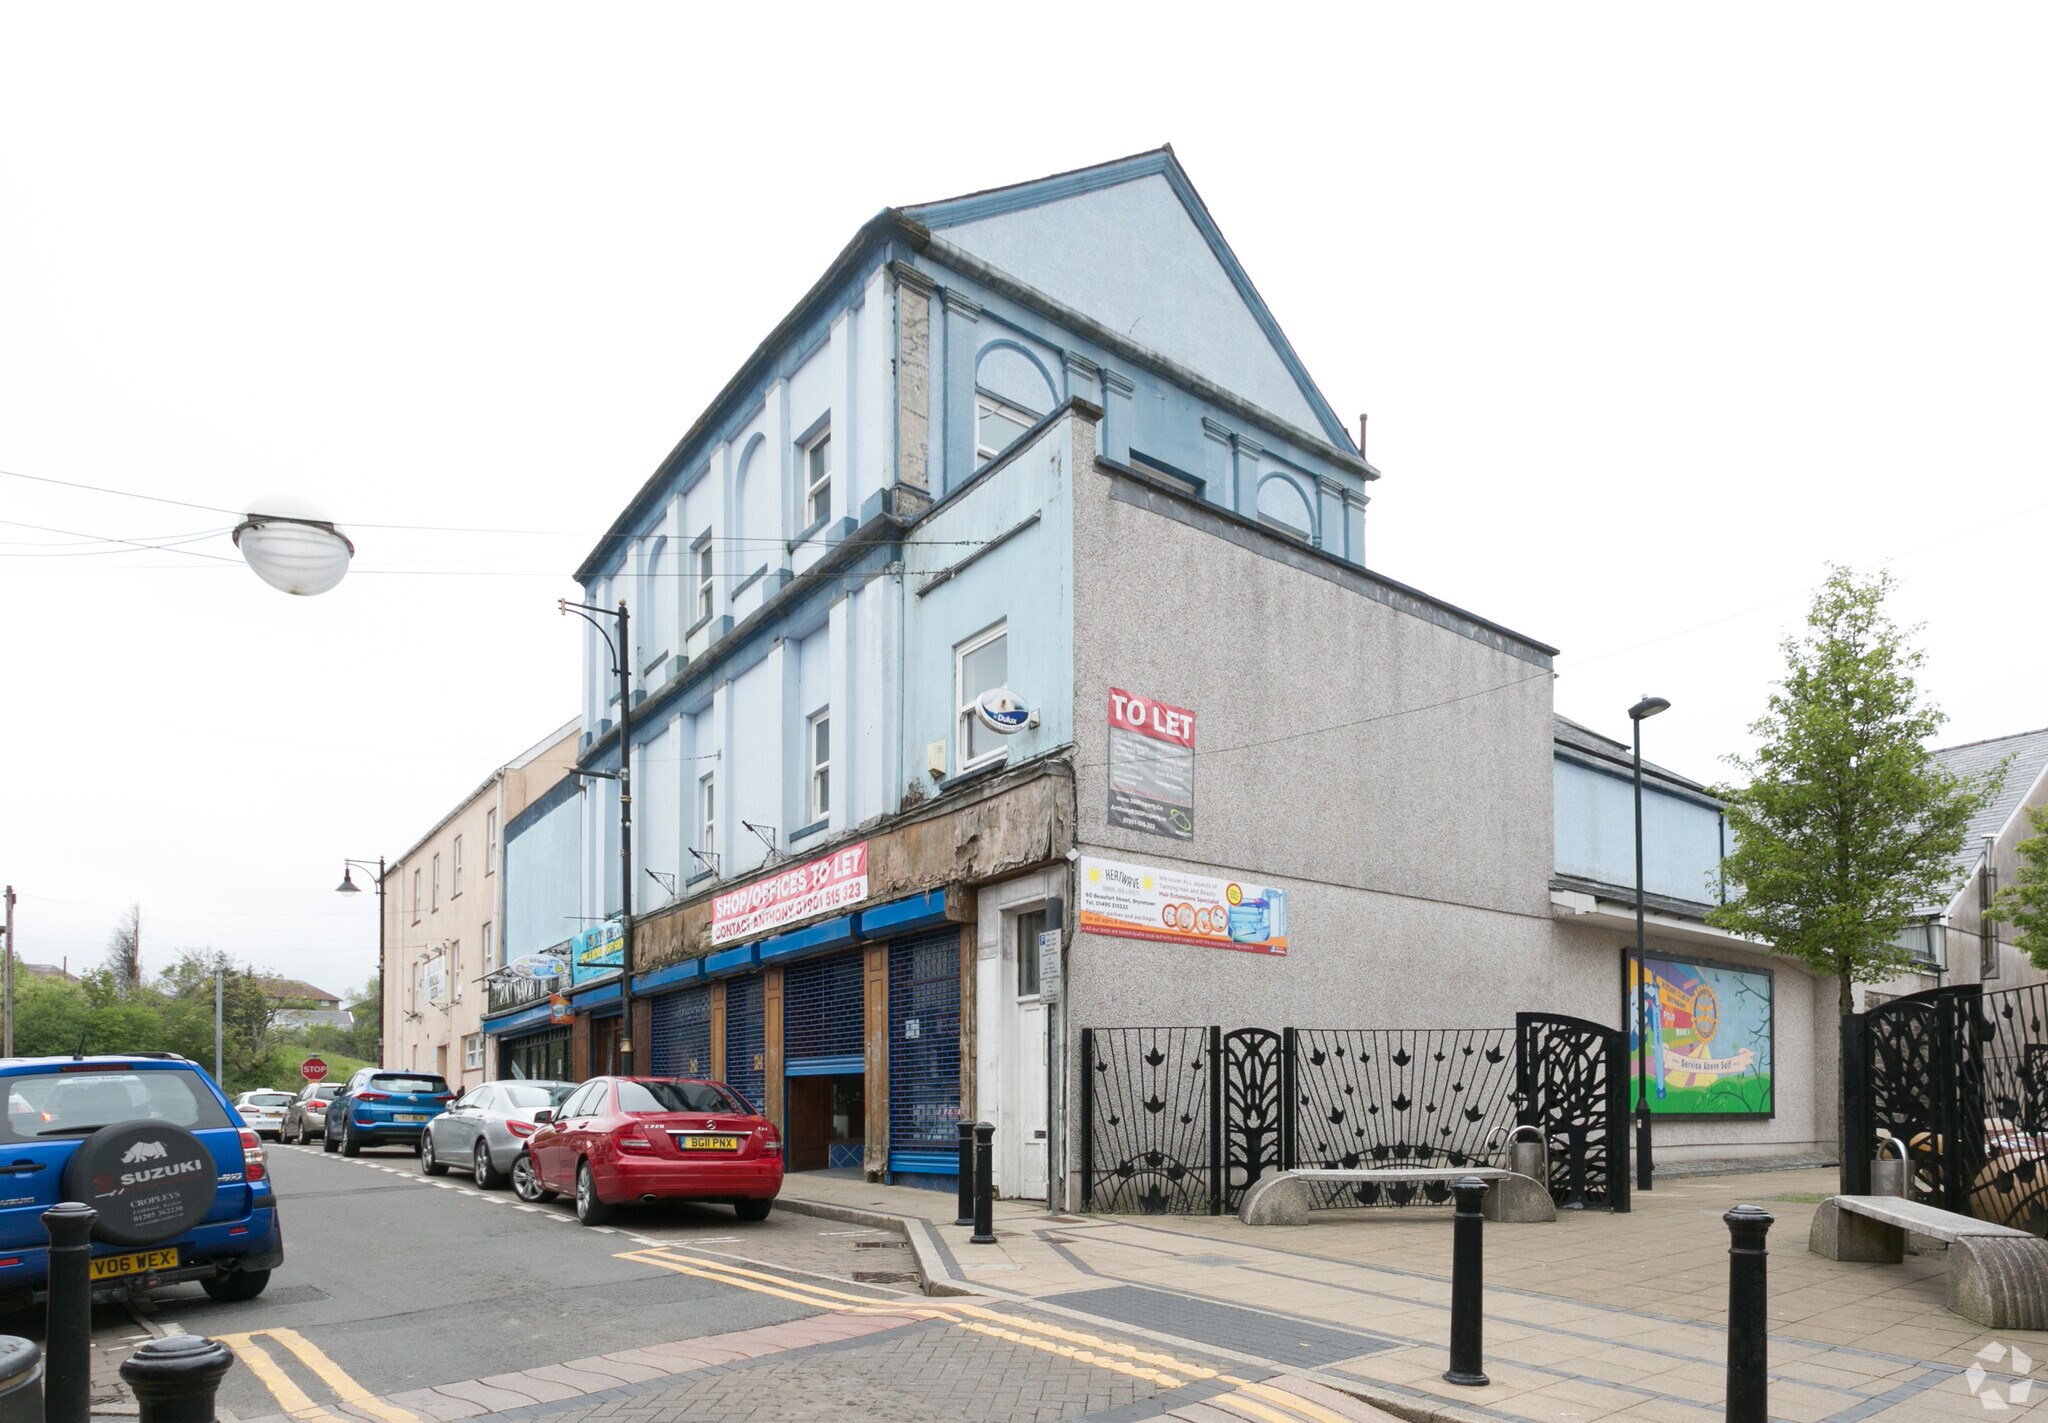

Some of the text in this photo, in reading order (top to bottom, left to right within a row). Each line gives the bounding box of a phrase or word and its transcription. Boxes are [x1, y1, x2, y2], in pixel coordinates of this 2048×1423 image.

[998, 713, 1017, 725] Dulux
[1111, 693, 1193, 740] TO LET
[716, 847, 862, 920] SHOP/OFFICES TO LET
[1105, 869, 1140, 890] HEATWAVE
[1158, 883, 1178, 891] Tanning
[715, 918, 751, 940] CONTACT
[753, 905, 794, 930] ANTHONY
[826, 889, 840, 907] 515
[843, 881, 861, 901] 323
[303, 1065, 327, 1073] STOP
[1681, 1058, 1702, 1069] Service
[1703, 1060, 1719, 1070] Above
[1721, 1060, 1732, 1069] Self
[713, 1138, 733, 1149] PNX
[120, 1159, 202, 1186] SUZUKI
[130, 1191, 181, 1208] CROPLEYS
[136, 1250, 171, 1270] WEX
